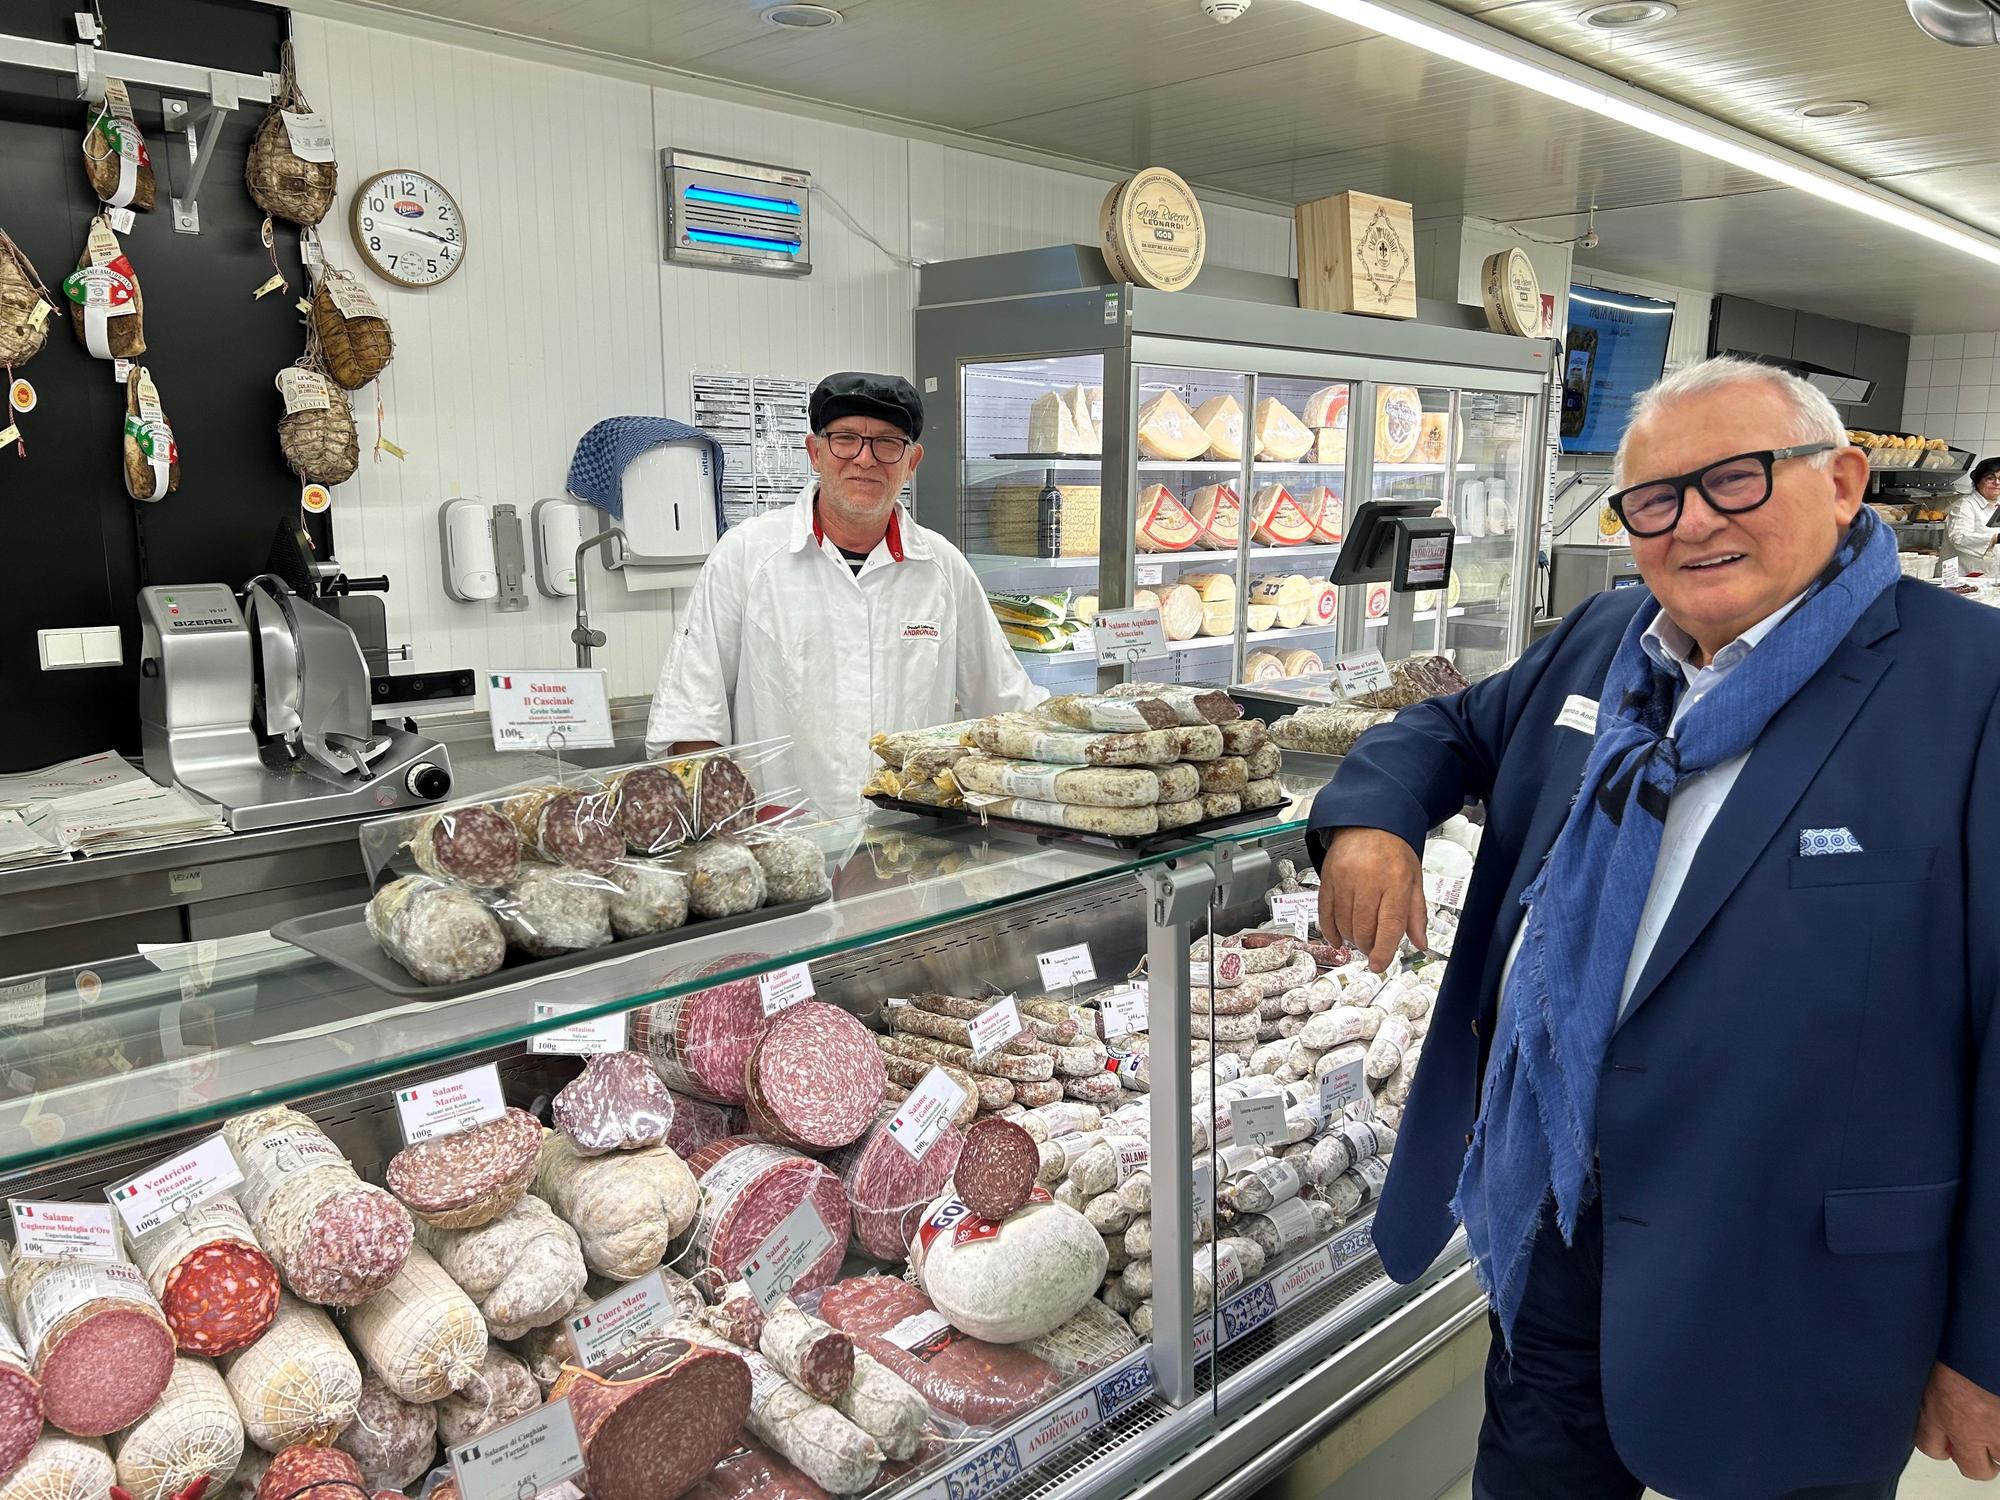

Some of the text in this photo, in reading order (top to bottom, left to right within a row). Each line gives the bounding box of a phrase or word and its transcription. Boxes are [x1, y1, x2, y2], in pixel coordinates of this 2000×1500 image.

[385, 185, 395, 199] 11
[402, 181, 416, 196] 12
[424, 189, 428, 203] 1
[369, 197, 384, 212] 10
[438, 206, 448, 220] 2
[363, 217, 374, 231] 9
[1143, 218, 1184, 230] LEONARDI
[445, 227, 455, 241] 3
[1156, 231, 1173, 239] IGOR
[369, 236, 381, 251] 8
[439, 246, 450, 260] 4
[388, 255, 398, 269] 7
[427, 259, 437, 273] 5
[701, 449, 709, 477] Initial
[173, 618, 234, 627] BIZERBA
[1109, 619, 1159, 629] Salame Aquilano
[903, 629, 939, 637] ANDRONACO
[530, 682, 567, 694] Salame
[533, 697, 575, 706] Cascinale
[499, 728, 525, 740] 100g
[538, 1042, 557, 1051] 100g
[432, 1083, 464, 1098] Salame
[435, 1093, 468, 1108] Mariola
[908, 1094, 928, 1116] Salame
[412, 1128, 433, 1141] 100g
[1121, 1151, 1148, 1164] SALAME
[144, 1160, 199, 1191] Ventricina
[156, 1174, 194, 1198] Piccante
[42, 1212, 75, 1222] Salame
[21, 1222, 111, 1237] Ungherese Medaglia d'Oro
[135, 1215, 161, 1234] 100g
[765, 1235, 789, 1259] Salame
[772, 1247, 792, 1266] Napoli
[1281, 1260, 1325, 1294] ANDRONACO
[596, 1291, 648, 1323] Cuore Matto
[587, 1348, 608, 1365] 100g
[1028, 1406, 1089, 1453] ANDRONACO
[485, 1444, 509, 1458] Salame
[518, 1423, 549, 1443] Cinghiale
